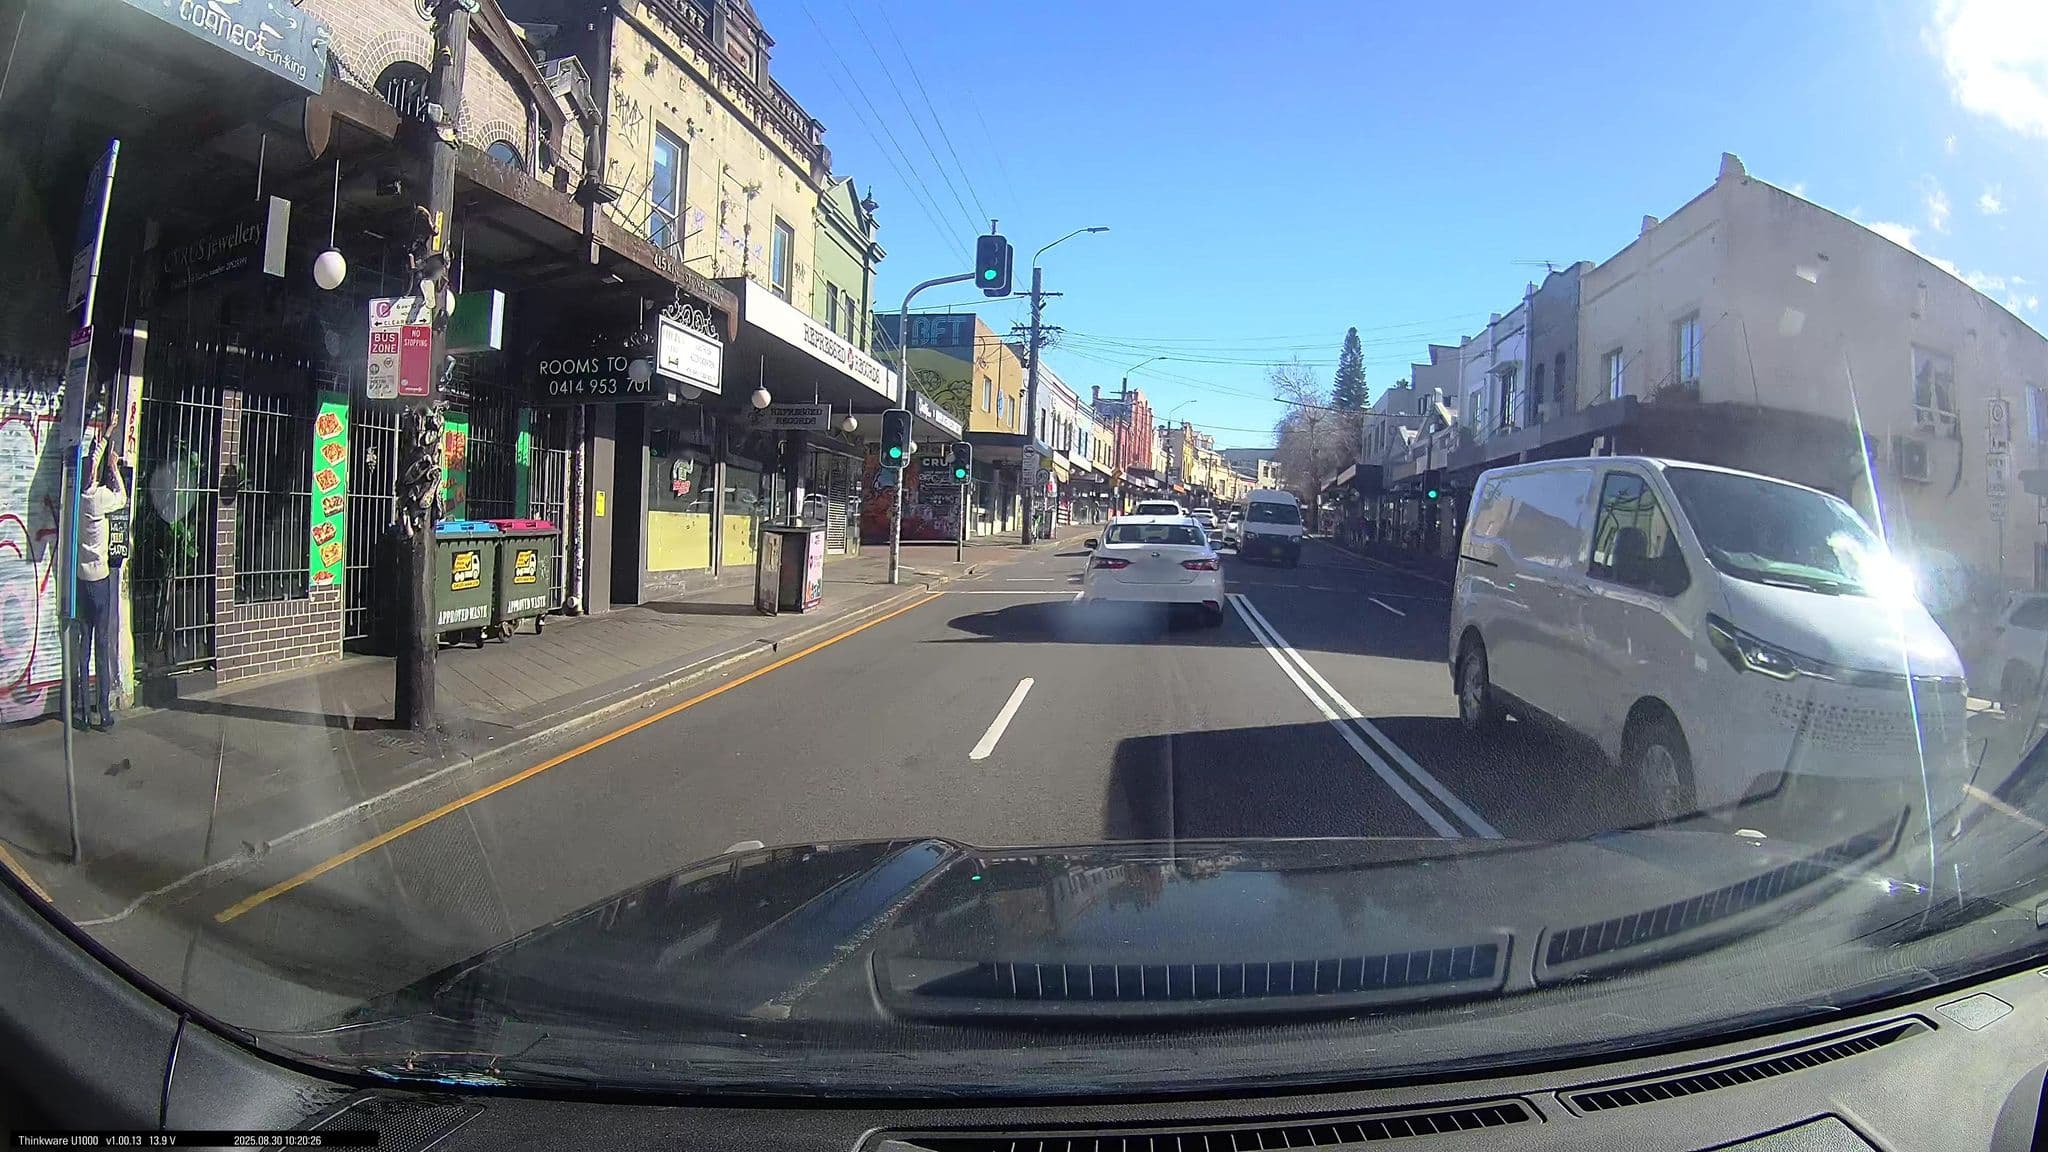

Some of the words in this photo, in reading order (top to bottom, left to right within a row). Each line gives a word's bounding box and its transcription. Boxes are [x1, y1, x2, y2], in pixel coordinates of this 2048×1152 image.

[653, 253, 667, 271] 415
[374, 333, 396, 343] BUS
[411, 329, 421, 338] NO
[371, 343, 397, 354] ZONE
[403, 338, 428, 348] STOPPING
[803, 322, 846, 365] REPRESSED
[854, 354, 880, 384] RECORDS
[540, 358, 599, 375] ROOMS
[606, 356, 628, 372] TO
[549, 379, 584, 396] 0414
[589, 378, 618, 394] 953
[507, 598, 531, 614] APPROVED
[438, 607, 470, 625] APPROVED
[469, 605, 488, 620] WASTE
